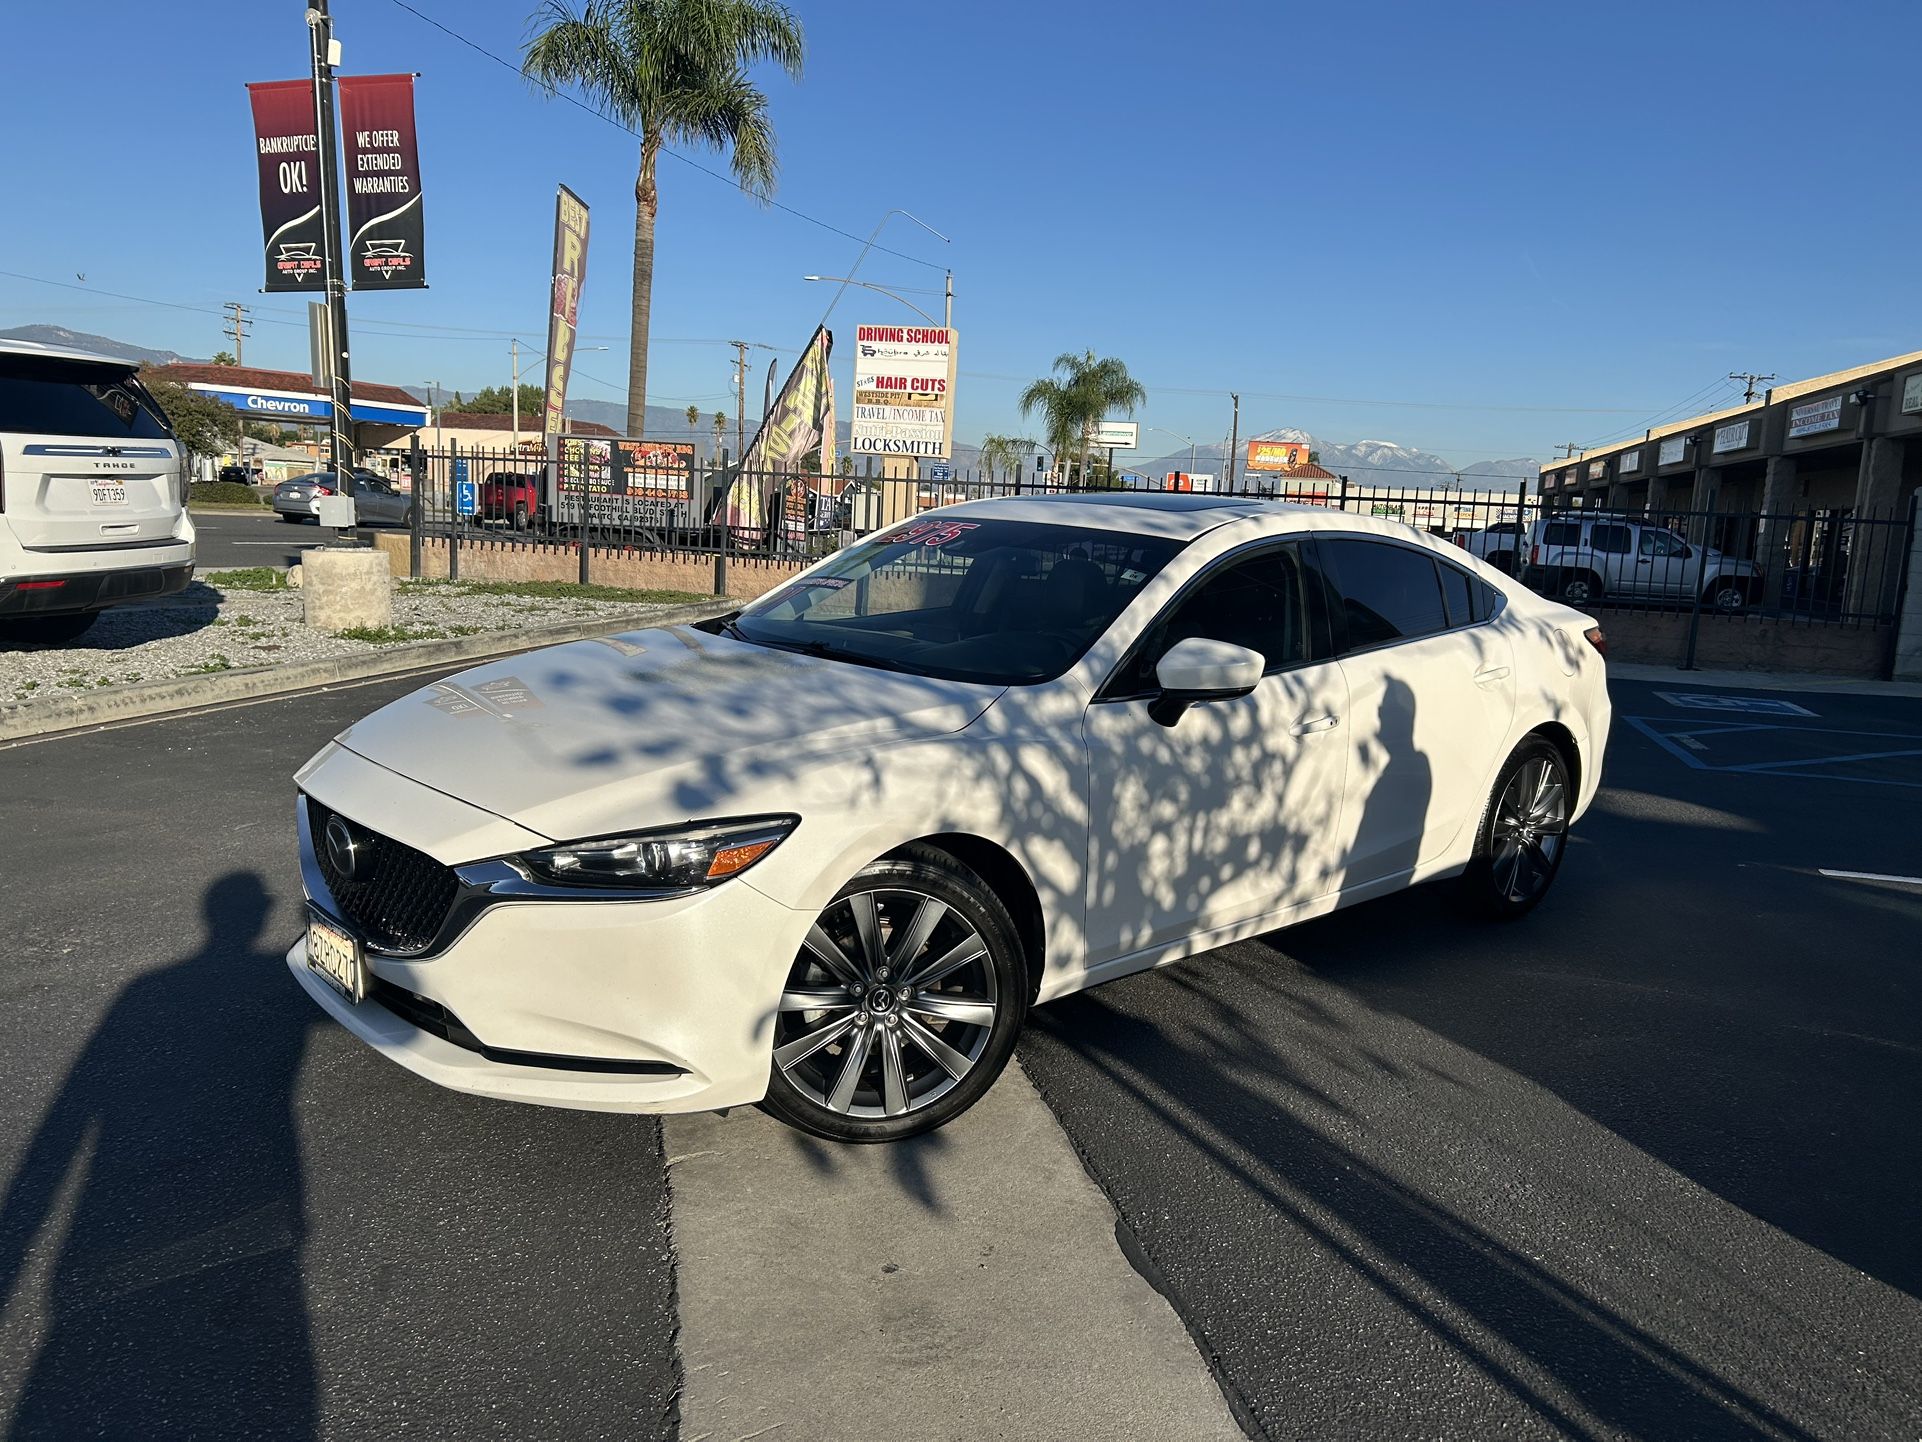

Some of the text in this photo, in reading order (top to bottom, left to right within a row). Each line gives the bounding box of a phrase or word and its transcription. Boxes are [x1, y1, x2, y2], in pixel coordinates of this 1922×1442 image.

[259, 135, 317, 153] BANKRUPTCIE
[356, 130, 400, 148] WE OFFER
[357, 153, 402, 171] EXTENDED
[279, 160, 308, 193] OK!
[353, 176, 409, 194] WARRANTIES
[559, 188, 588, 240] BEST
[858, 326, 950, 345] DRIVING SCHOOL
[875, 376, 908, 390] HAIR
[910, 377, 946, 393] CUTS
[247, 396, 309, 413] Chevron
[928, 410, 946, 423] TAX
[1792, 414, 1822, 427] INCOME
[853, 437, 944, 455] LOCKSMITH
